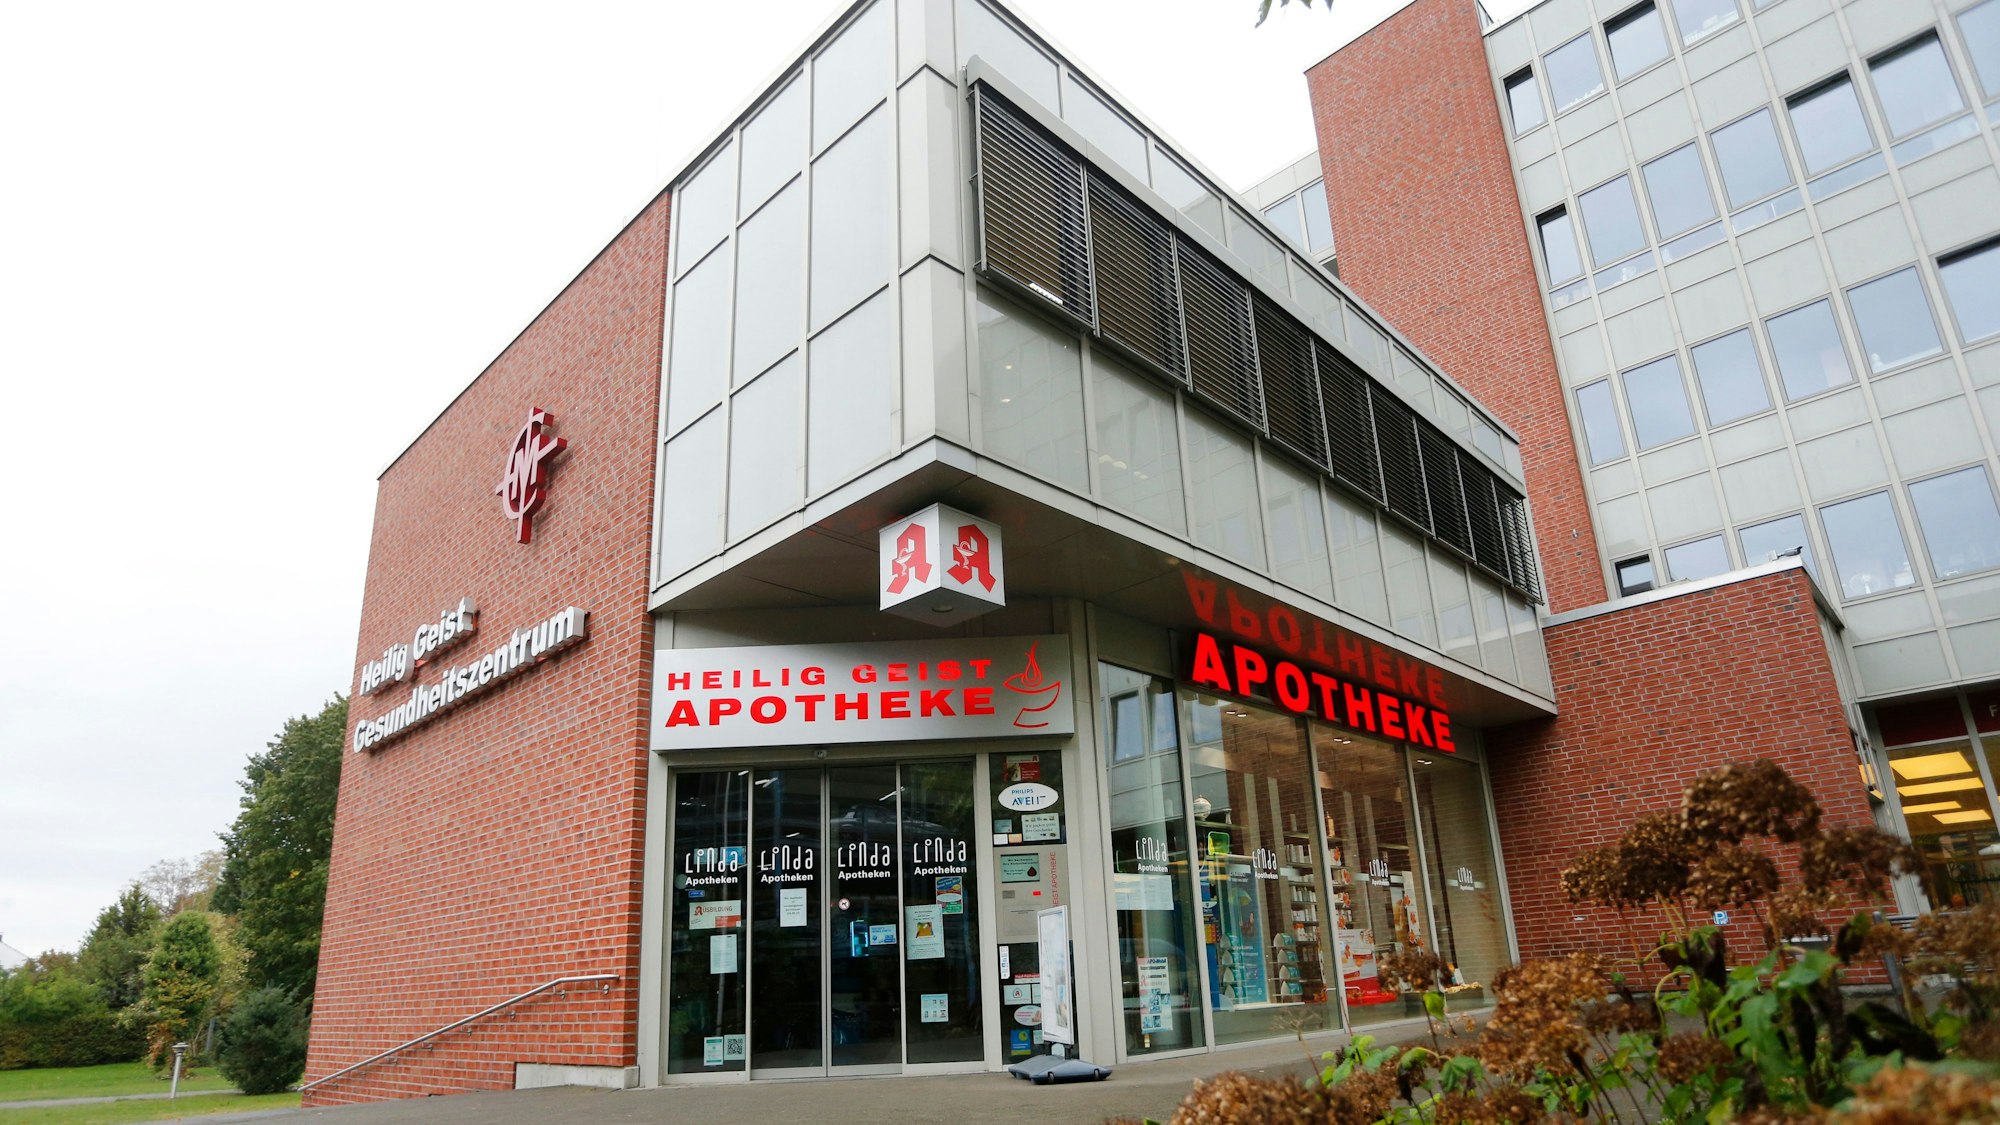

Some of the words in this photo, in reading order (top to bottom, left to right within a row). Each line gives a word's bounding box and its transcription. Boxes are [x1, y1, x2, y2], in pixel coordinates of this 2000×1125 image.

[359, 643, 413, 697] Heilig
[413, 597, 472, 661] Geist
[353, 606, 583, 753] Gesundheitszentrum
[667, 667, 826, 691] HEILIG
[852, 659, 992, 684] GEIST
[1192, 633, 1456, 753] APOTHEKE
[665, 687, 995, 728] APOTHEKE
[838, 870, 891, 880] Apotheken
[914, 865, 967, 876] Apotheken
[1050, 852, 1058, 889] APOTHEKE
[1137, 863, 1169, 873] Apotheken
[1254, 871, 1279, 880] Apotheken
[685, 876, 738, 886] Apotheken
[760, 872, 813, 883] Apotheken
[1052, 890, 1060, 908] EIST
